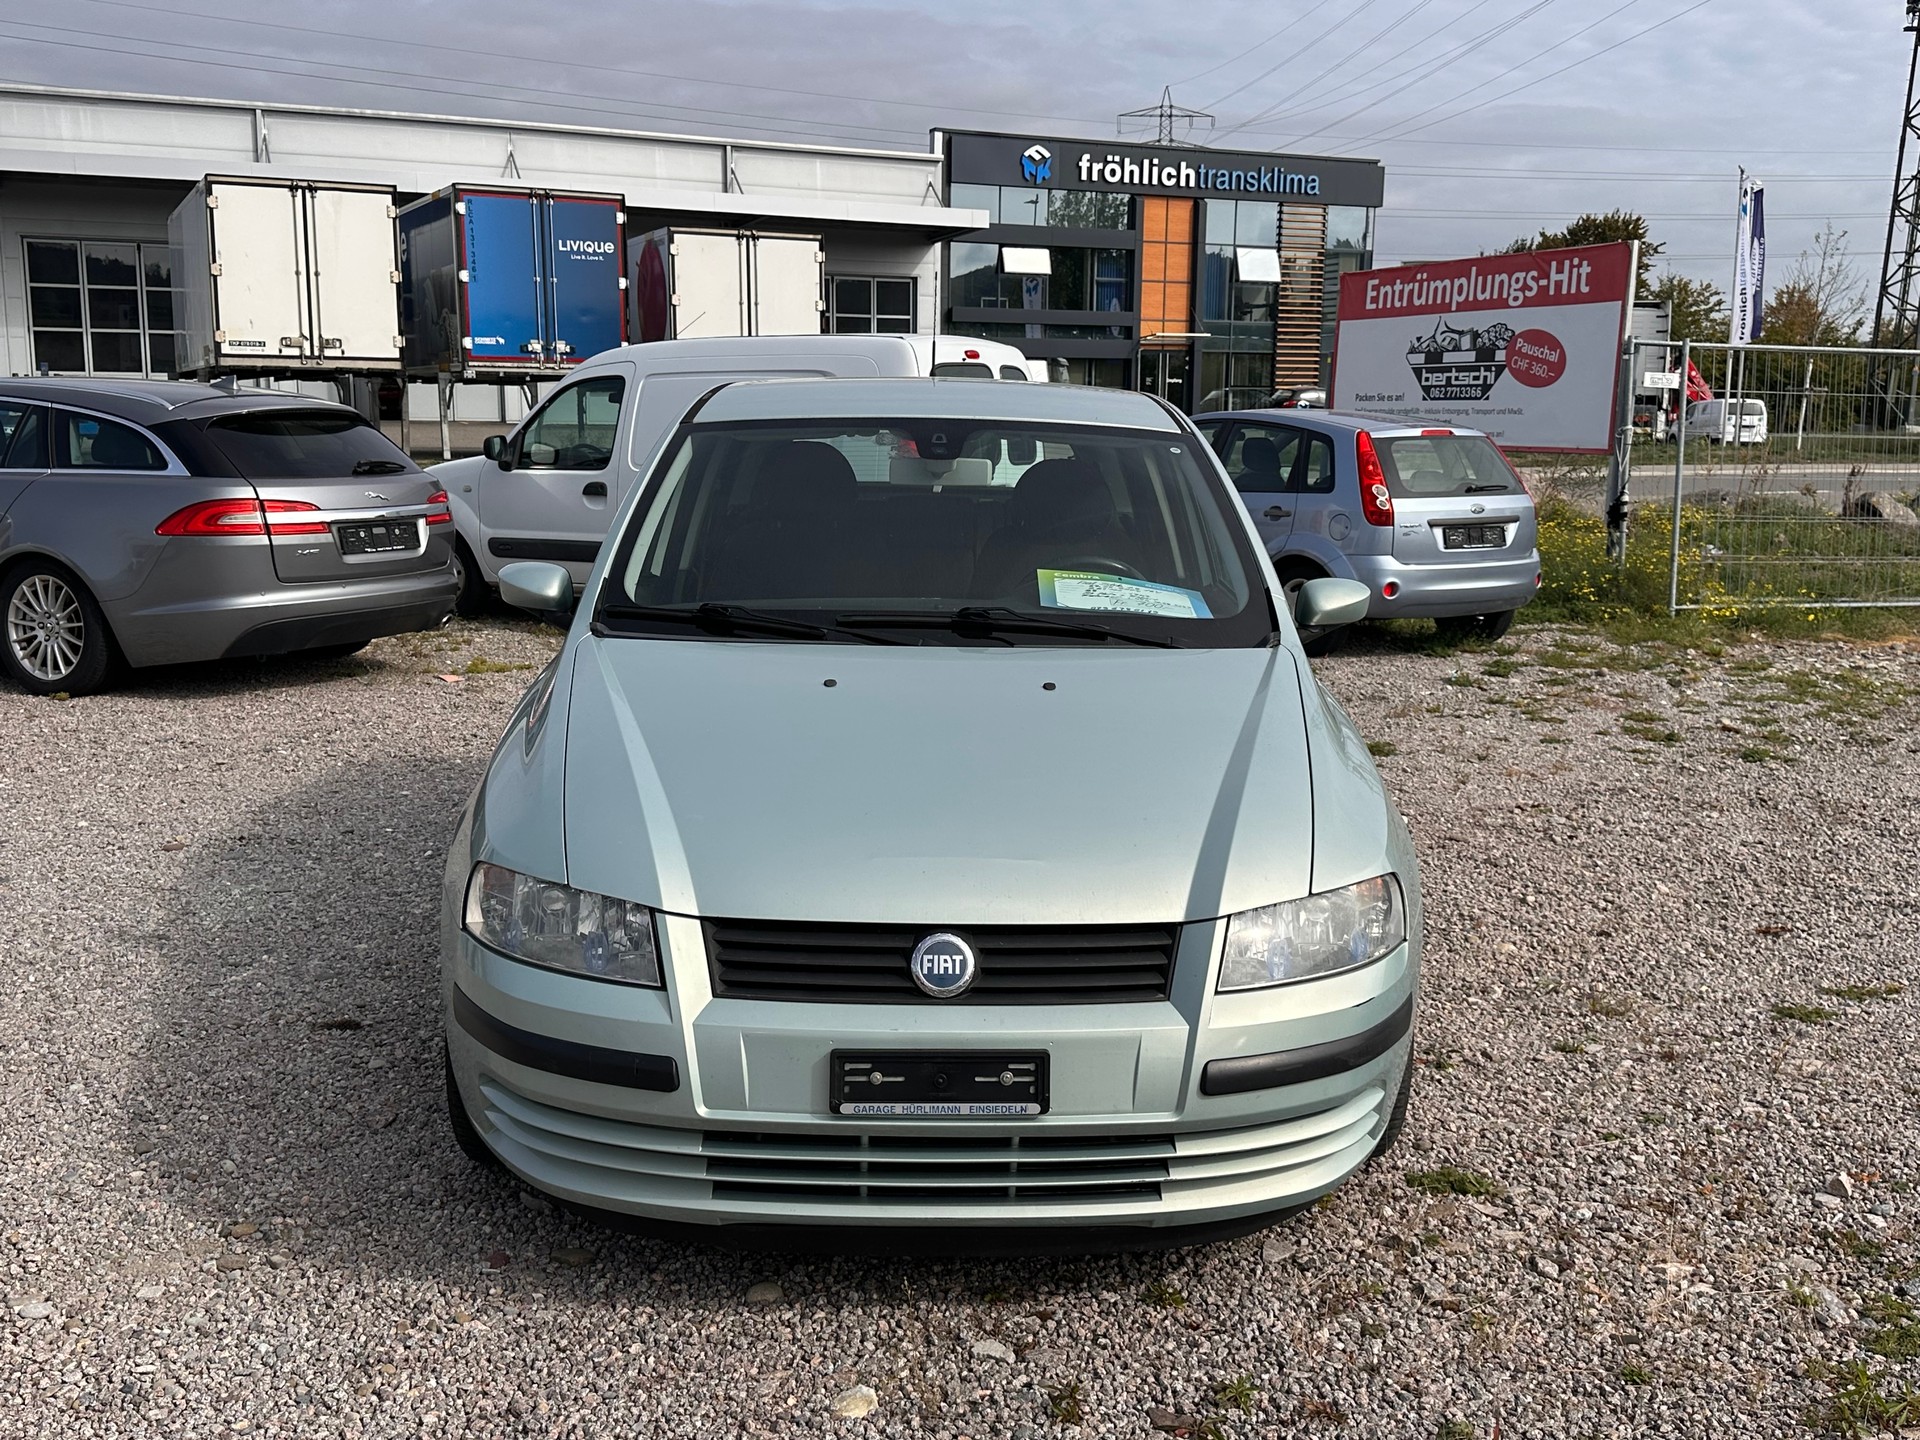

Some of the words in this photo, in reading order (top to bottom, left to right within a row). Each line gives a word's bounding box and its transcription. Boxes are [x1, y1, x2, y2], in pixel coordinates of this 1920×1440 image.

[1365, 257, 1592, 312] Entrümplungs-Hit
[1515, 338, 1560, 363] Pauschal
[1511, 356, 1530, 371] CHF
[1421, 366, 1496, 386] bertschi
[1355, 393, 1375, 402] Packen
[1376, 393, 1386, 401] Sie
[1394, 393, 1405, 401] an!
[1430, 387, 1445, 398] 062
[1446, 386, 1482, 398] 7713366
[1471, 408, 1495, 416] Transport
[1053, 572, 1101, 580] Cembra
[922, 954, 964, 975] FIAT
[853, 1105, 896, 1114] GARAGE
[902, 1103, 961, 1114] HÜRLIMANN
[969, 1105, 1027, 1114] EINSIEDELN
